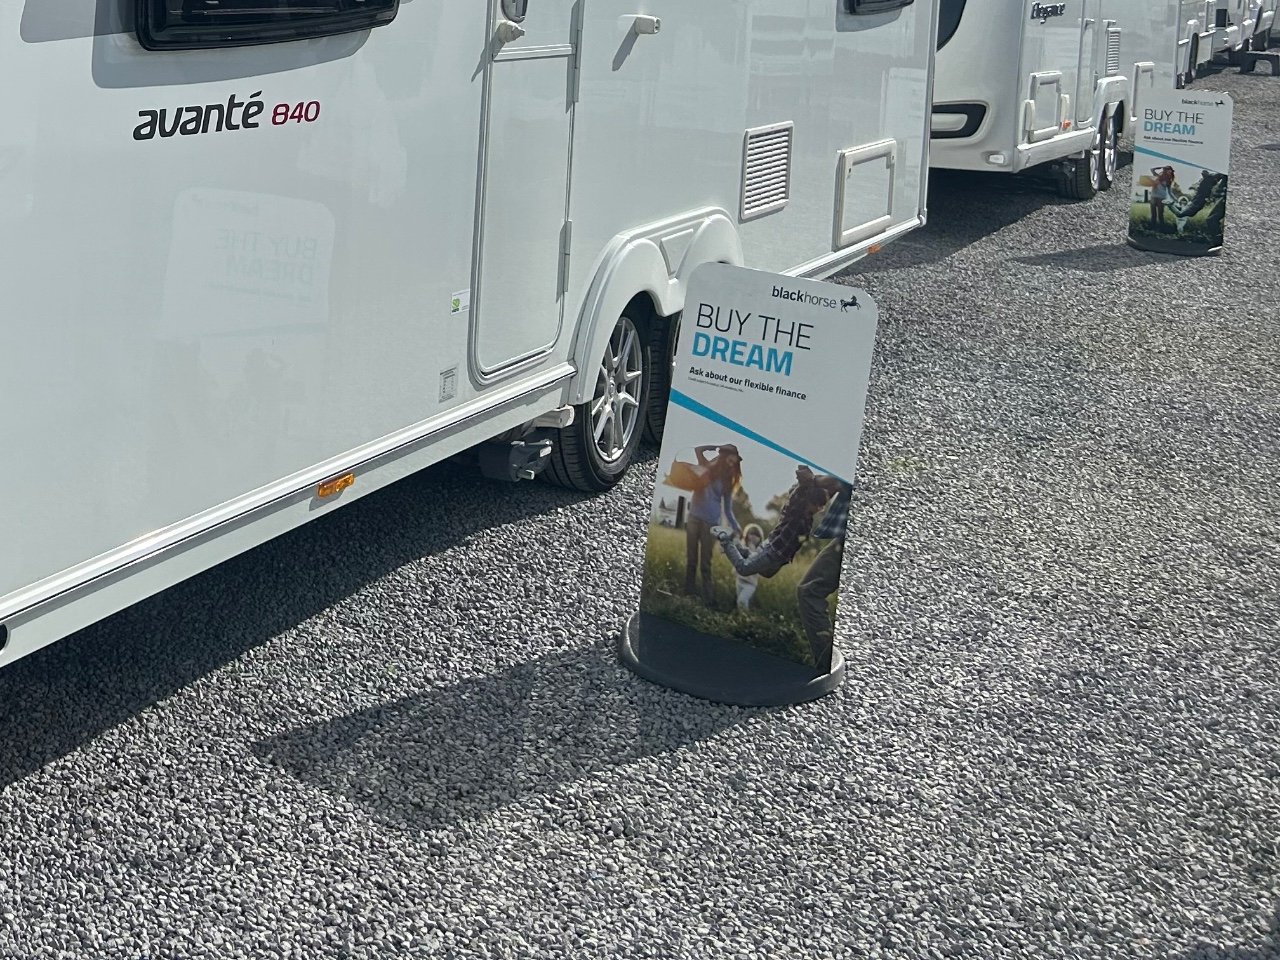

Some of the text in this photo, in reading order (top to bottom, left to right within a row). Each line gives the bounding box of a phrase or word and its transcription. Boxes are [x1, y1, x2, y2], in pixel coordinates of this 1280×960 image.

[132, 90, 321, 141] avanté 840
[1143, 121, 1196, 136] DREAM
[1144, 108, 1205, 125] BUY THE
[771, 285, 837, 309] blackhorse
[696, 303, 814, 351] BUY THE
[691, 331, 794, 377] DREAM
[689, 366, 704, 377] Ask
[704, 369, 728, 382] about
[729, 375, 743, 386] our
[743, 378, 774, 393] flexible
[775, 385, 807, 401] finance
